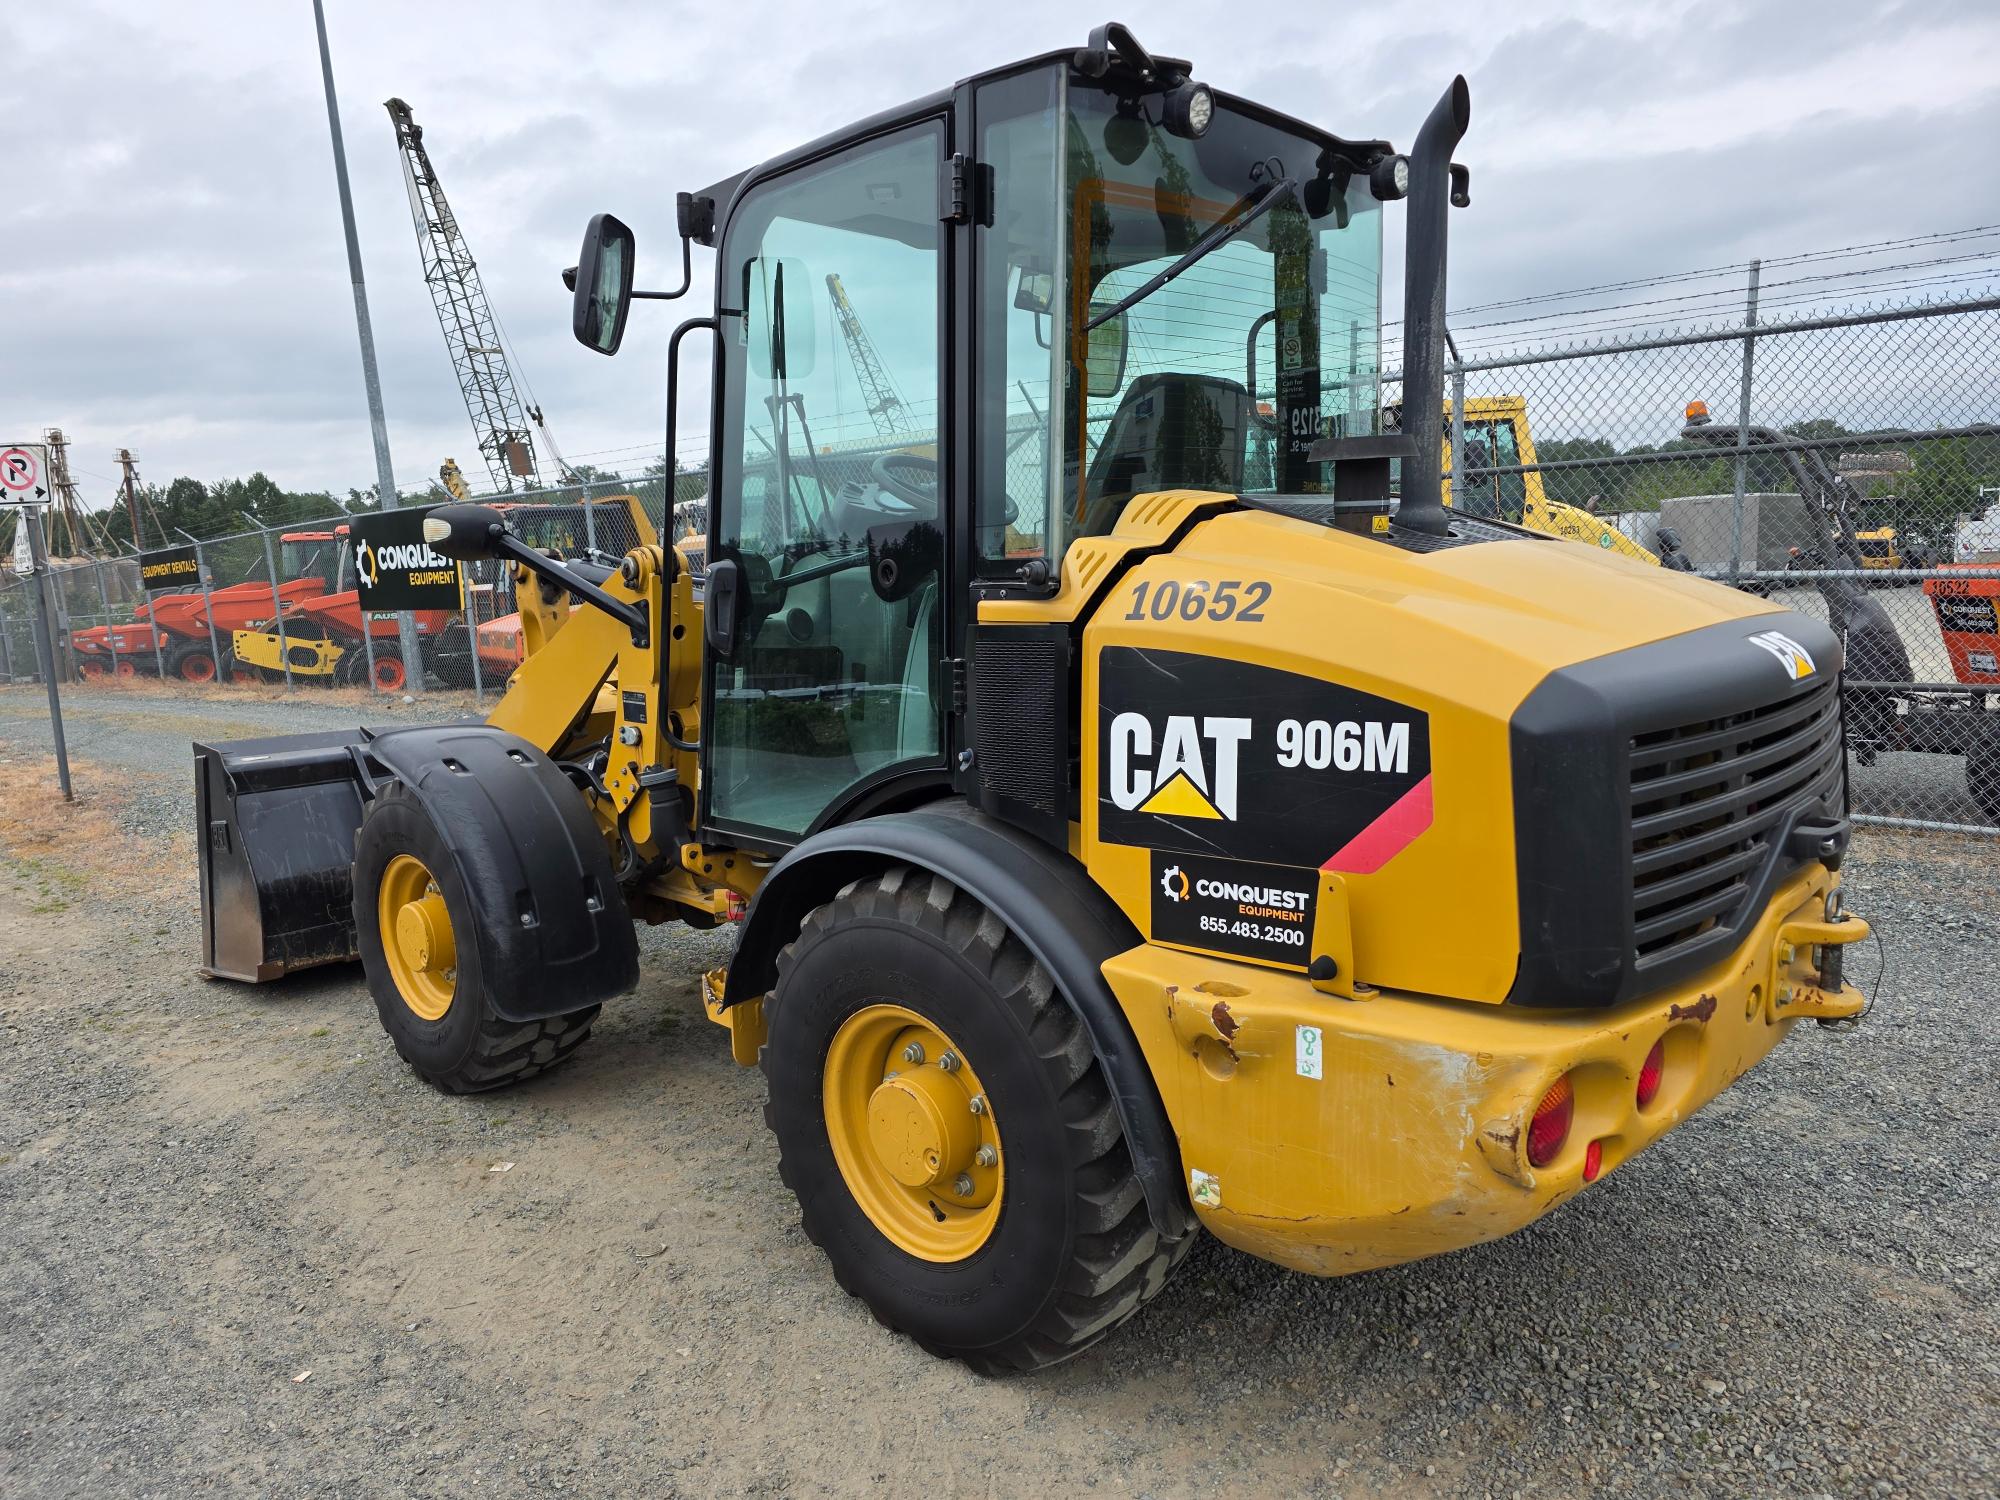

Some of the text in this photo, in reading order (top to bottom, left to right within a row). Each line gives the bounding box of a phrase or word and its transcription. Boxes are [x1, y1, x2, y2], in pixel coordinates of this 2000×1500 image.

[143, 559, 197, 578] EQUIPMENT RENTALS
[377, 544, 454, 571] CONQUES
[409, 570, 455, 585] EQUIPMENT
[374, 612, 398, 620] AUS
[1125, 580, 1273, 622] 10652
[1748, 631, 1816, 680] CAT
[1276, 719, 1410, 774] 906M
[1110, 712, 1251, 822] CAT
[1196, 879, 1309, 911] CONQUEST
[1238, 904, 1305, 923] EQUIPMENT
[1200, 915, 1305, 947] 855.483.2500
